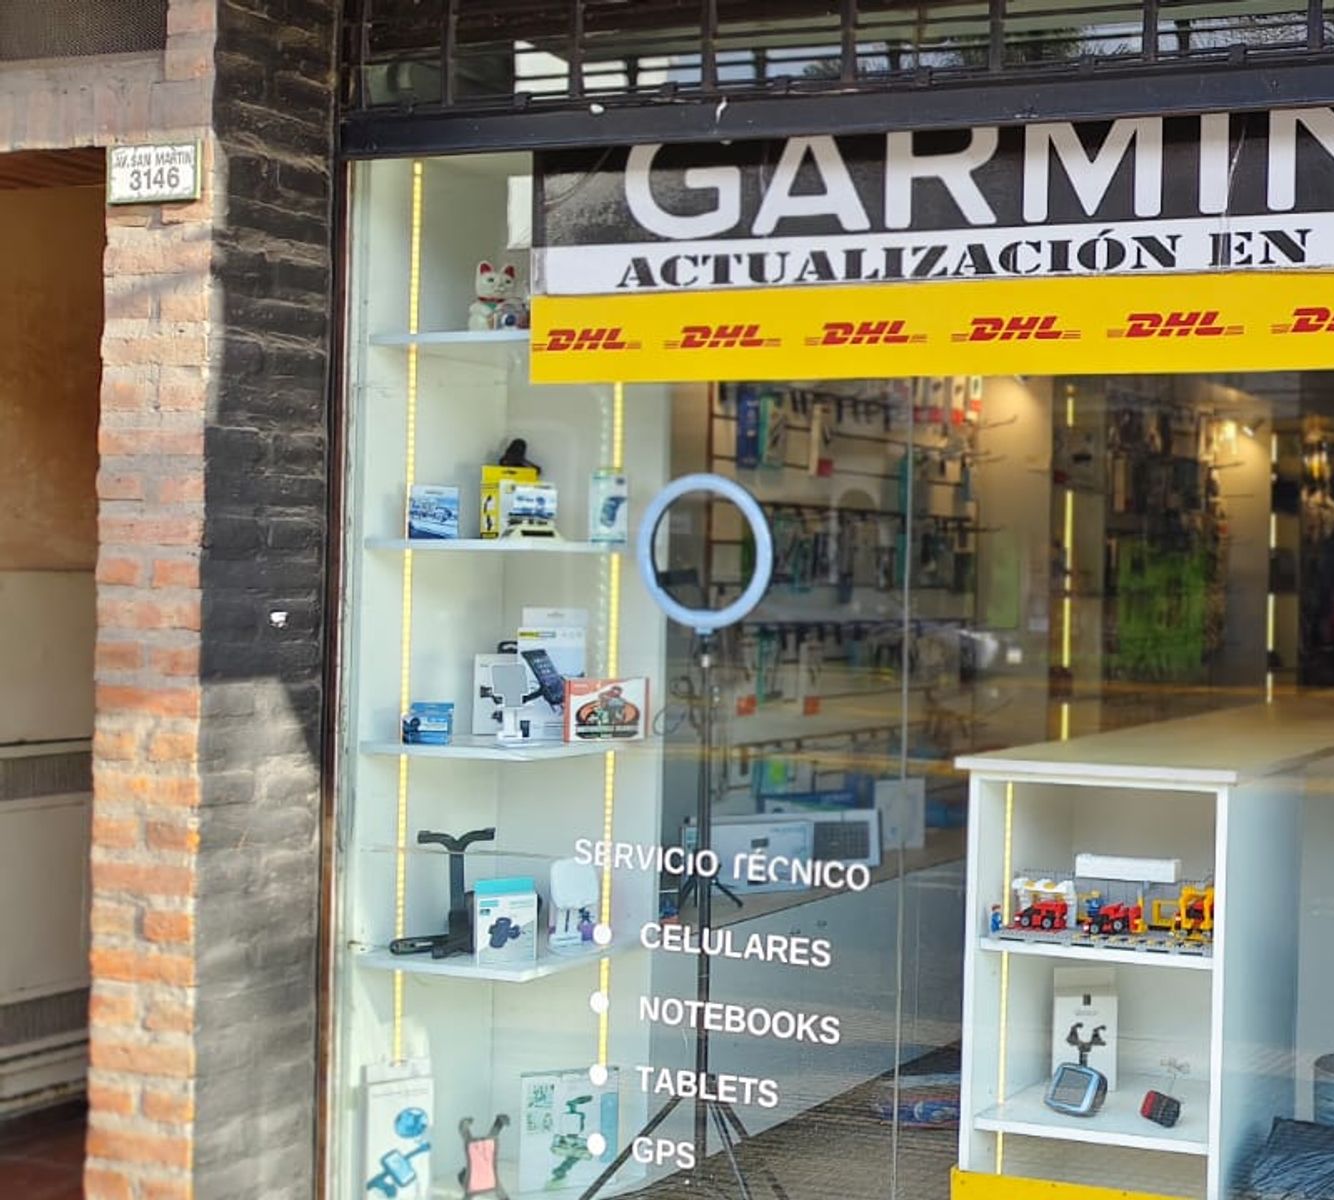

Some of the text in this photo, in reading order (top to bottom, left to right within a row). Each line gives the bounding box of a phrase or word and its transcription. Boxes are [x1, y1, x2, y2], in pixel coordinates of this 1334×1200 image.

[129, 166, 180, 191] 3146
[616, 229, 1184, 288] ACTUALIZACIÓN
[1210, 227, 1313, 268] EN
[547, 327, 627, 352] DHL
[678, 324, 766, 349] DHL
[821, 320, 909, 345] DHL
[969, 315, 1065, 342] DHL
[1125, 311, 1226, 338] DHL
[573, 838, 871, 892] SERVICIO TÉCNICO
[640, 921, 832, 968] CELULARES
[639, 996, 842, 1045] NOTEBOOKS
[636, 1065, 779, 1109] TABLETS
[631, 1136, 696, 1169] GPS
